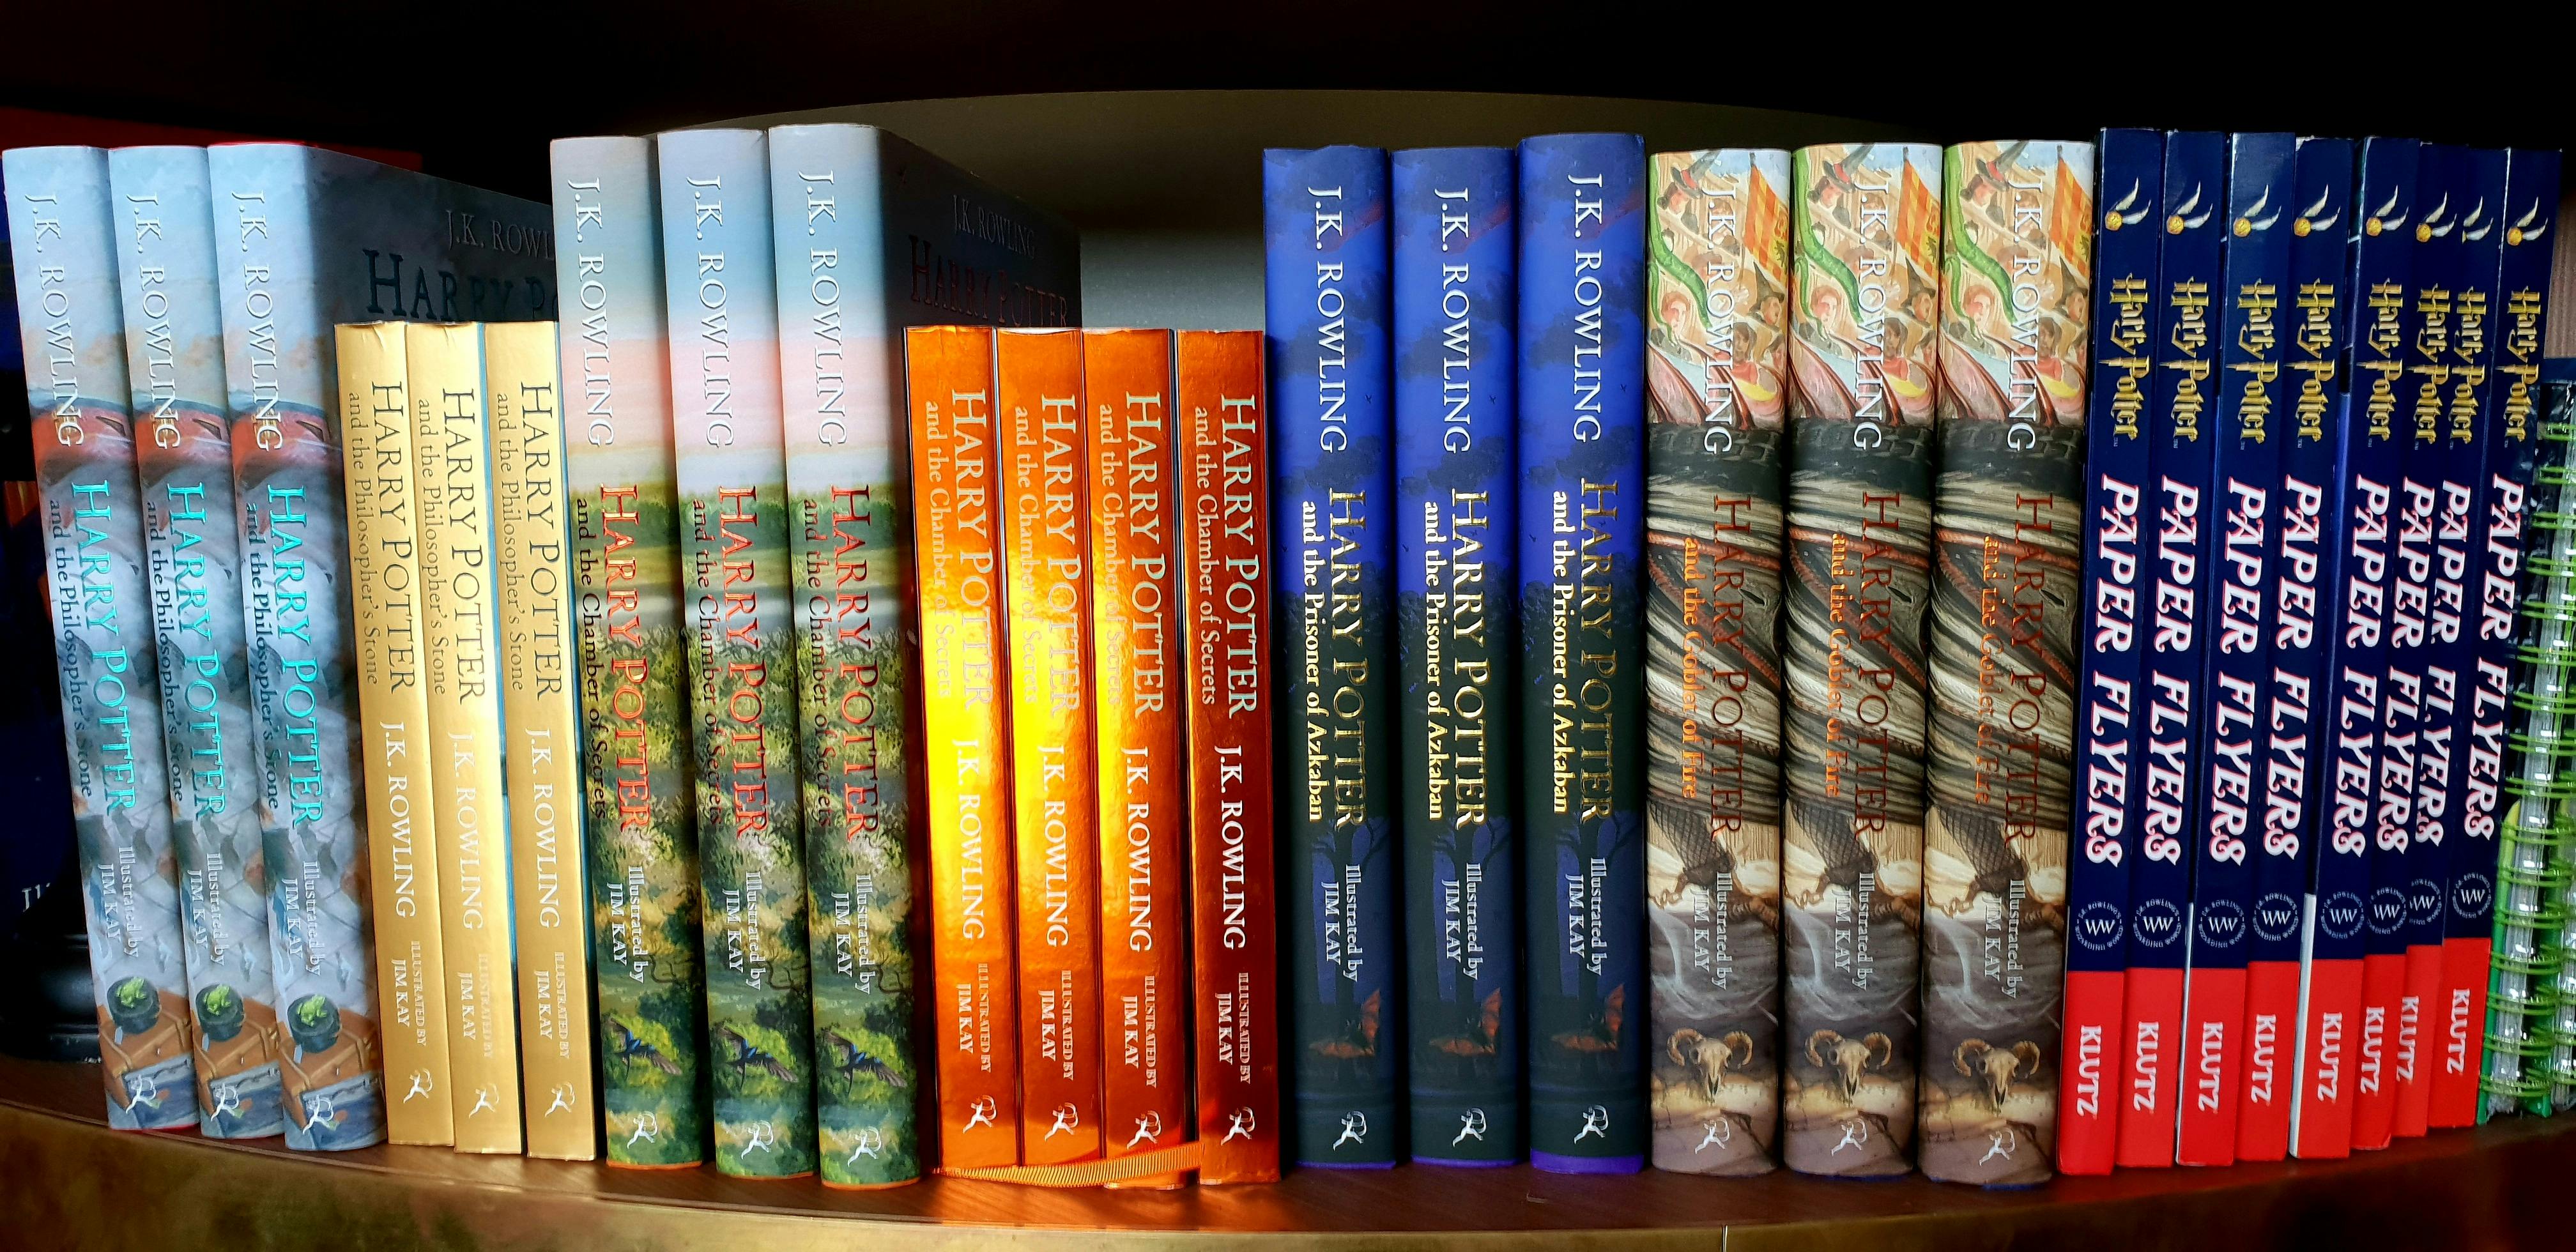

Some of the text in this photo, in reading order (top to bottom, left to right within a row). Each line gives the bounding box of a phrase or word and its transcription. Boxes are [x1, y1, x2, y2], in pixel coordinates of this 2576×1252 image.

[25, 193, 84, 447] J.K. ROWLING
[232, 190, 283, 452] J.K. ROWLING
[568, 177, 613, 447] J.K. ROWLING
[799, 170, 847, 447] J.K. ROWLING
[1308, 186, 1347, 454] J.K. ROWLING
[1434, 187, 1471, 454] J.K. ROWLING
[1568, 174, 1602, 443] J.K. ROWLING
[1701, 186, 1736, 455] J.K. ROWLING
[2006, 178, 2043, 452] J.K. ROWLING
[2099, 273, 2150, 441] Harry Potter
[2159, 276, 2210, 442] Harry Potter
[2356, 277, 2404, 441] Harry Potter
[250, 553, 268, 588] the
[349, 393, 380, 685] and the Philosopher's Stone
[372, 381, 415, 694] HARRY POTTER
[443, 388, 486, 705] HARRY POTTER
[521, 381, 562, 701] HARRY POTTER
[951, 388, 994, 710] HARRY POTTER
[1041, 393, 1082, 718] HARRY POTTER
[1126, 390, 1166, 719] HARRY POTTER
[1195, 406, 1222, 705] and the Chamber of Secrets
[1221, 394, 1260, 719] HARRY POTTER
[2346, 473, 2390, 648] PAPER
[2391, 476, 2435, 648] PAPER
[2430, 480, 2471, 645] PAPER
[2480, 472, 2524, 641] PAPER
[72, 480, 135, 816] HARRY POTTER
[167, 482, 226, 821] HARRY POTTER
[254, 592, 280, 741] Philosopher's
[268, 484, 323, 829] HARRY POTTER
[576, 498, 609, 819] and the Chamber of Secrets
[600, 484, 652, 832] HARRY POTTER
[719, 485, 769, 840] HARRY POTTER
[830, 484, 880, 843] HARRY POTTER
[1301, 500, 1330, 822] and the Prisoner of Azkaban
[1329, 487, 1368, 831] HARRY POTTER
[1452, 487, 1491, 831] HARRY POTTER
[1580, 477, 1618, 825] HARRY POTTER
[1682, 537, 1706, 799] and the Goblet of Fire
[1710, 494, 1751, 843] HARRY POTTER
[1854, 491, 1900, 841] HARRY POTTER
[2005, 492, 2053, 849] HARRY POTTER
[2085, 473, 2139, 868] PAPER FLYERS
[2143, 474, 2199, 866] PAPER FLYERS
[2209, 476, 2267, 867] PAPER FLYERS
[2263, 473, 2322, 860] PAPER FLYERS
[2464, 656, 2508, 841] FLYERS
[264, 749, 282, 810] Stone
[380, 721, 415, 918] J.K. ROWLING
[525, 727, 560, 928] J.K. ROWLING
[952, 739, 985, 940] J.K. ROWLING
[1120, 745, 1153, 952] J.K. ROWLING
[1215, 745, 1246, 950] J.K. ROWLING
[2332, 664, 2377, 859] FLYERS
[2375, 664, 2420, 855] FLYERS
[2415, 665, 2456, 847] FLYERS
[282, 878, 303, 959] JIM KAY
[303, 860, 326, 976] Illustrated by
[392, 959, 410, 1027] JIM KAY
[606, 883, 627, 966] JIM KAY
[628, 866, 648, 984] Illustrated by
[1321, 882, 1340, 965] JIM KAY
[1343, 864, 1363, 982] Illustrated by
[1690, 888, 1710, 972] JIM KAY
[1712, 872, 1733, 991] Illustrated by
[417, 1031, 426, 1047] BY
[1215, 992, 1233, 1065] JIM KAY
[1239, 1065, 1250, 1085] BY
[2076, 1025, 2102, 1118] KLUTZ
[2133, 1021, 2159, 1113] KLUTZ
[2197, 1021, 2223, 1113] KLUTZ
[2250, 1014, 2276, 1105] KLUTZ
[2317, 1012, 2343, 1103] KLUTZ
[2360, 1006, 2386, 1096] KLUTZ
[2396, 996, 2420, 1083] KLUTZ
[2446, 988, 2471, 1074] KLUTZ
